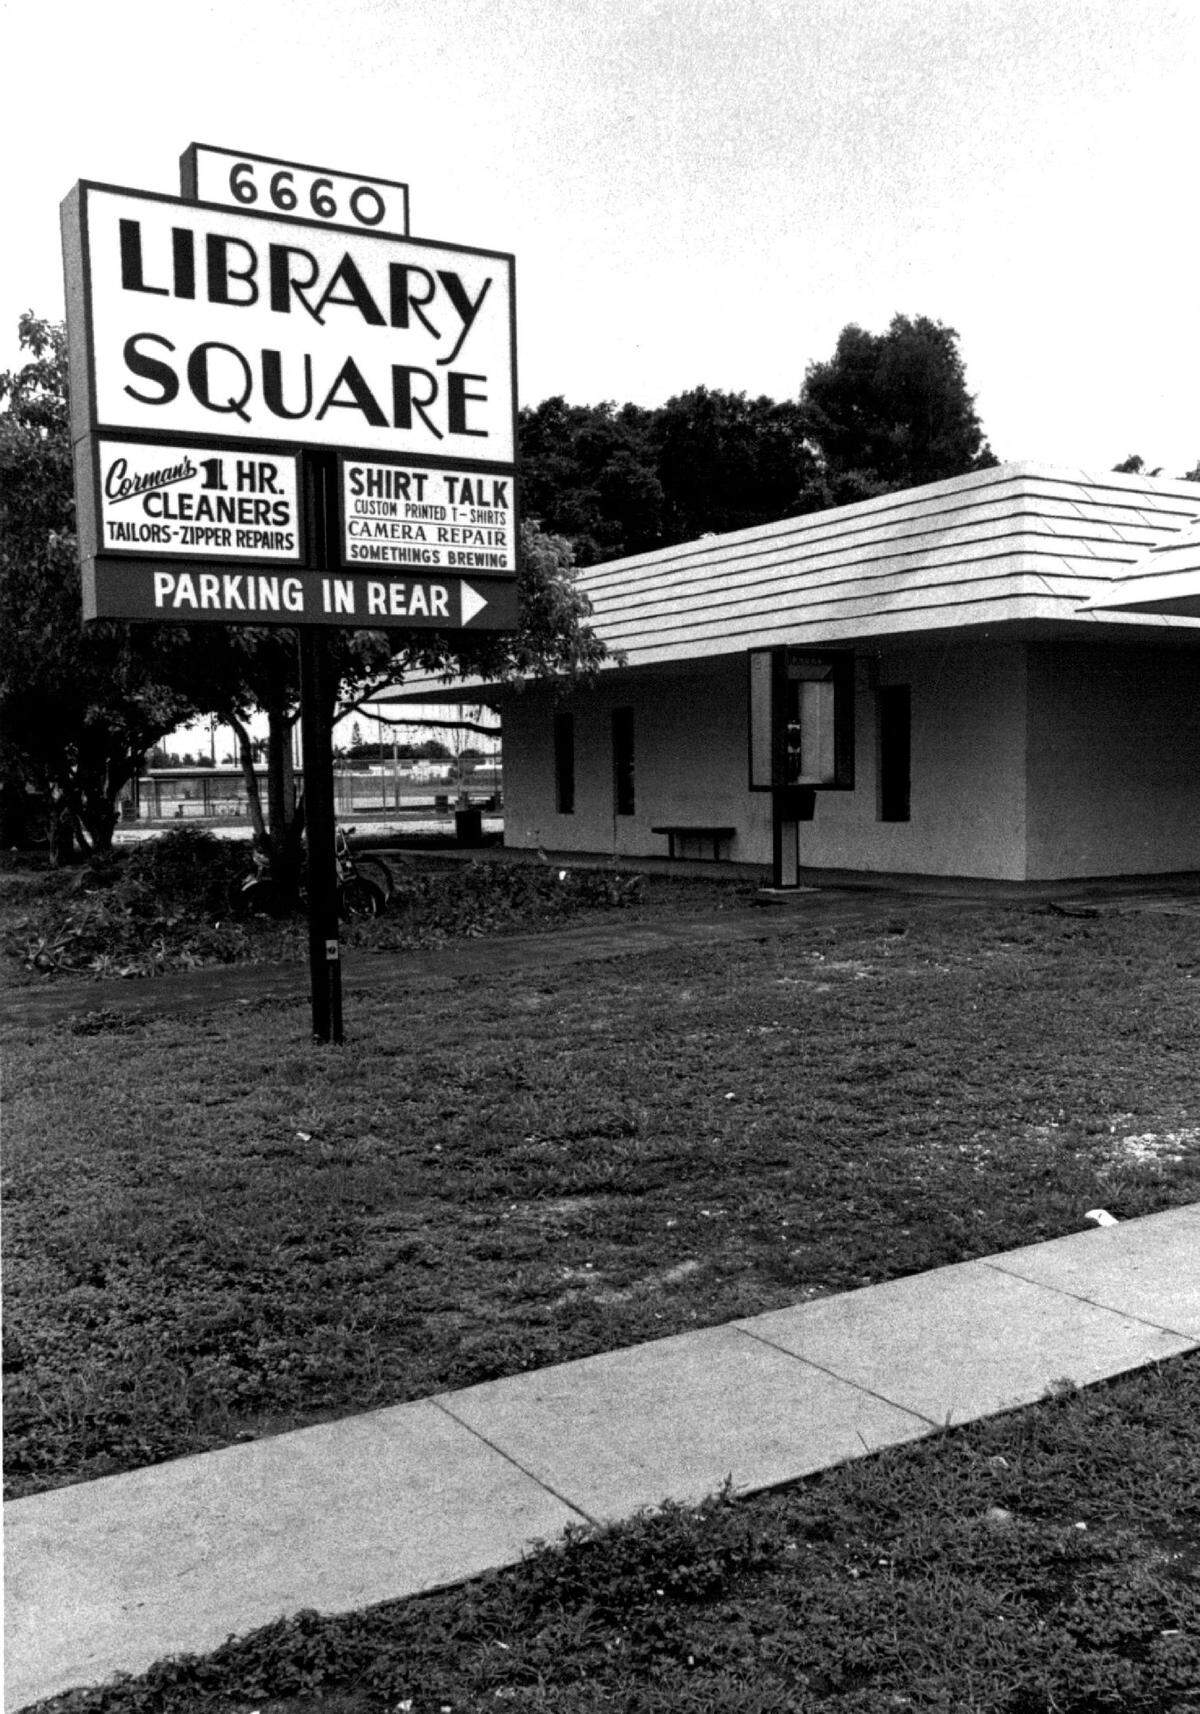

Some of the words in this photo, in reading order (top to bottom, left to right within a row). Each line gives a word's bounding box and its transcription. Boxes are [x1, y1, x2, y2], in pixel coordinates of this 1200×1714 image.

[229, 163, 386, 226] 6660
[119, 217, 493, 366] LIBRARY
[123, 332, 489, 440] SQUARE
[105, 455, 198, 504] Corman's
[200, 457, 229, 491] 1
[236, 459, 285, 495] HR.
[349, 467, 429, 502] SHIRT
[443, 475, 509, 510] TALK
[142, 491, 290, 527] CLEANERS
[354, 498, 398, 517] CUSTOM
[405, 503, 447, 522] PRINTED
[236, 529, 295, 551] REPAIRS
[348, 520, 427, 542] CAMERA
[438, 525, 507, 547] REPAIR
[351, 543, 441, 565] SOMETHINGS
[448, 550, 508, 569] BREWING
[153, 571, 305, 612] PARKING
[322, 578, 356, 614] IN
[367, 580, 450, 618] REAR
